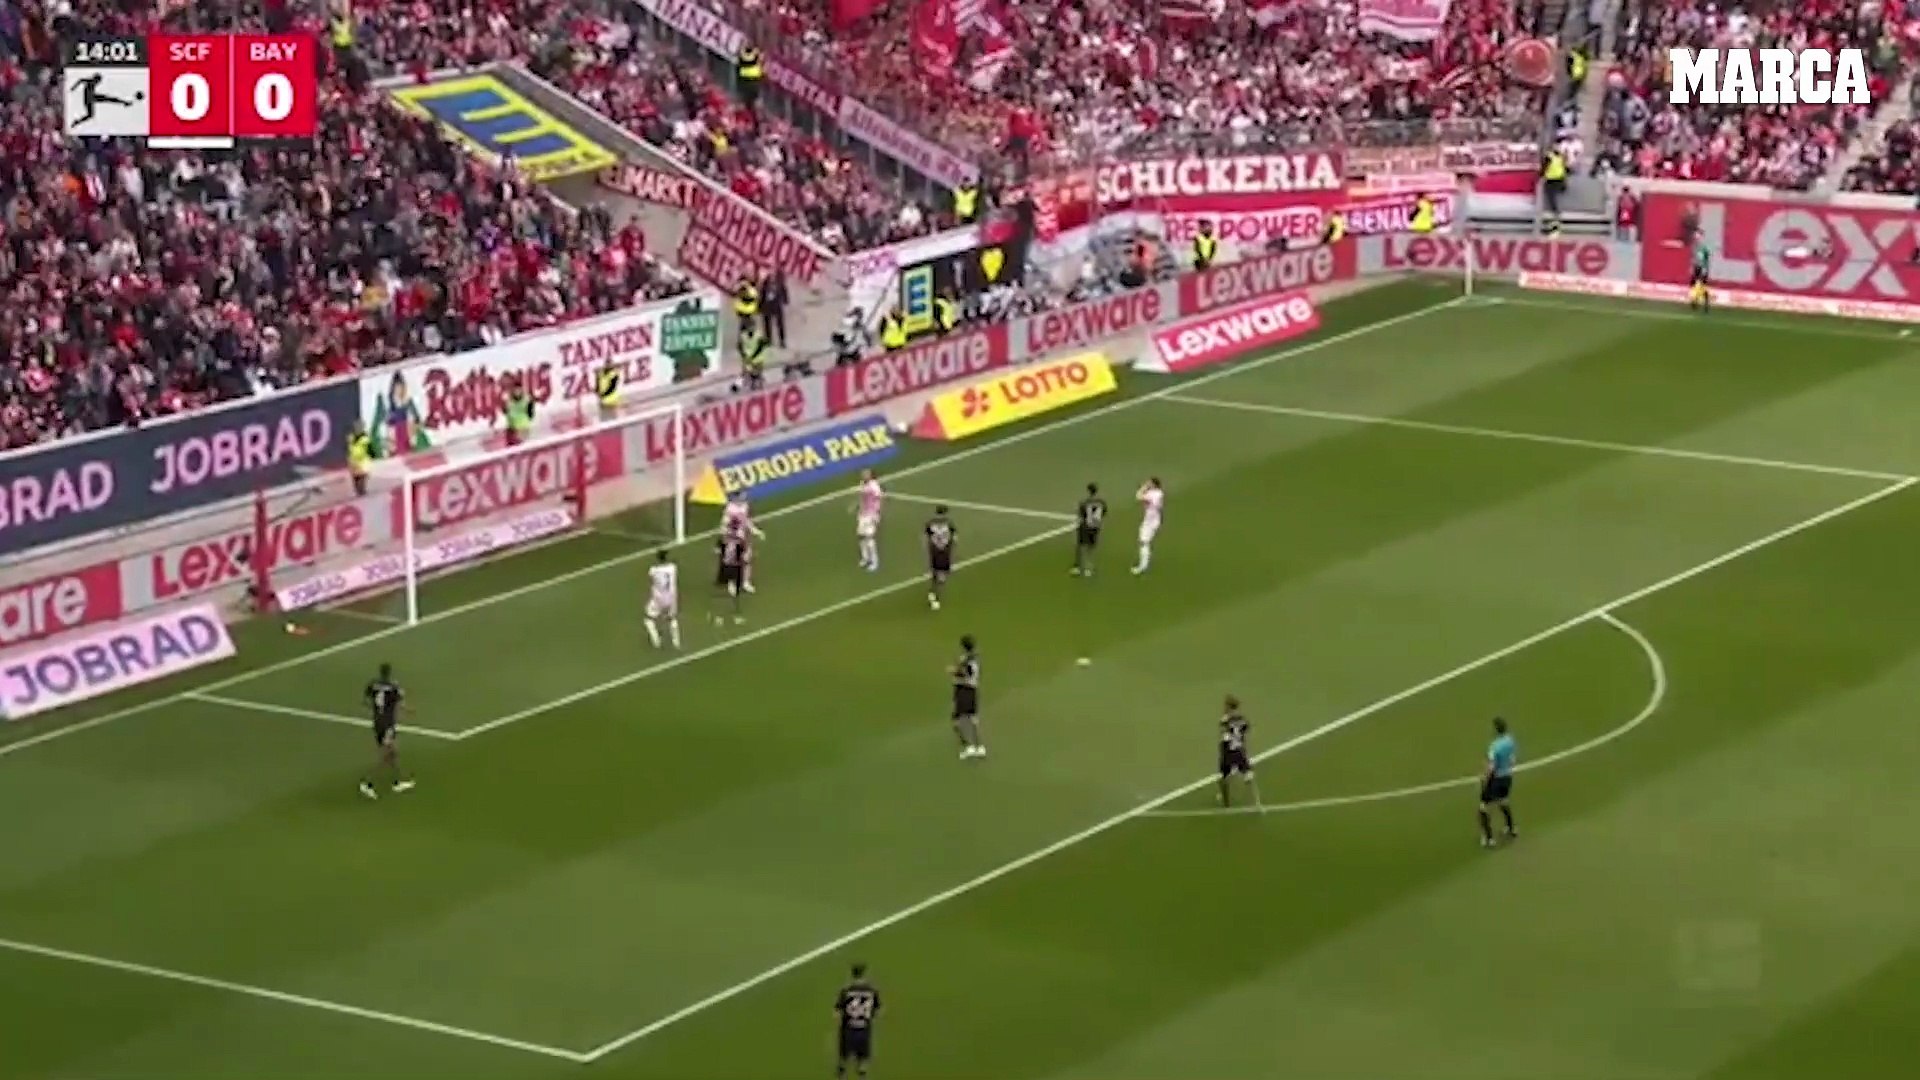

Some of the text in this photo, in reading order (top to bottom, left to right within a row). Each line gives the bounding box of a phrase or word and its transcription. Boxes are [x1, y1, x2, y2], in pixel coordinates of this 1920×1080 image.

[1097, 153, 1341, 203] SCHICKERIA
[1219, 212, 1320, 241] POWER
[1384, 237, 1609, 276] Lexware
[1700, 202, 1920, 298] Lex
[1197, 246, 1335, 308] Lexware
[559, 321, 653, 367] TANNEN
[1028, 287, 1160, 353] Lexware
[1158, 297, 1314, 363] Lexware
[847, 332, 992, 409] Lexware
[1000, 360, 1088, 405] LOTTO
[149, 408, 331, 494] JOBRAD
[646, 384, 805, 462] Lexware
[415, 440, 599, 525] Lexware
[720, 424, 895, 493] EUROPA PARK
[0, 462, 114, 530] RAD
[5, 614, 221, 706] JOBRAD
